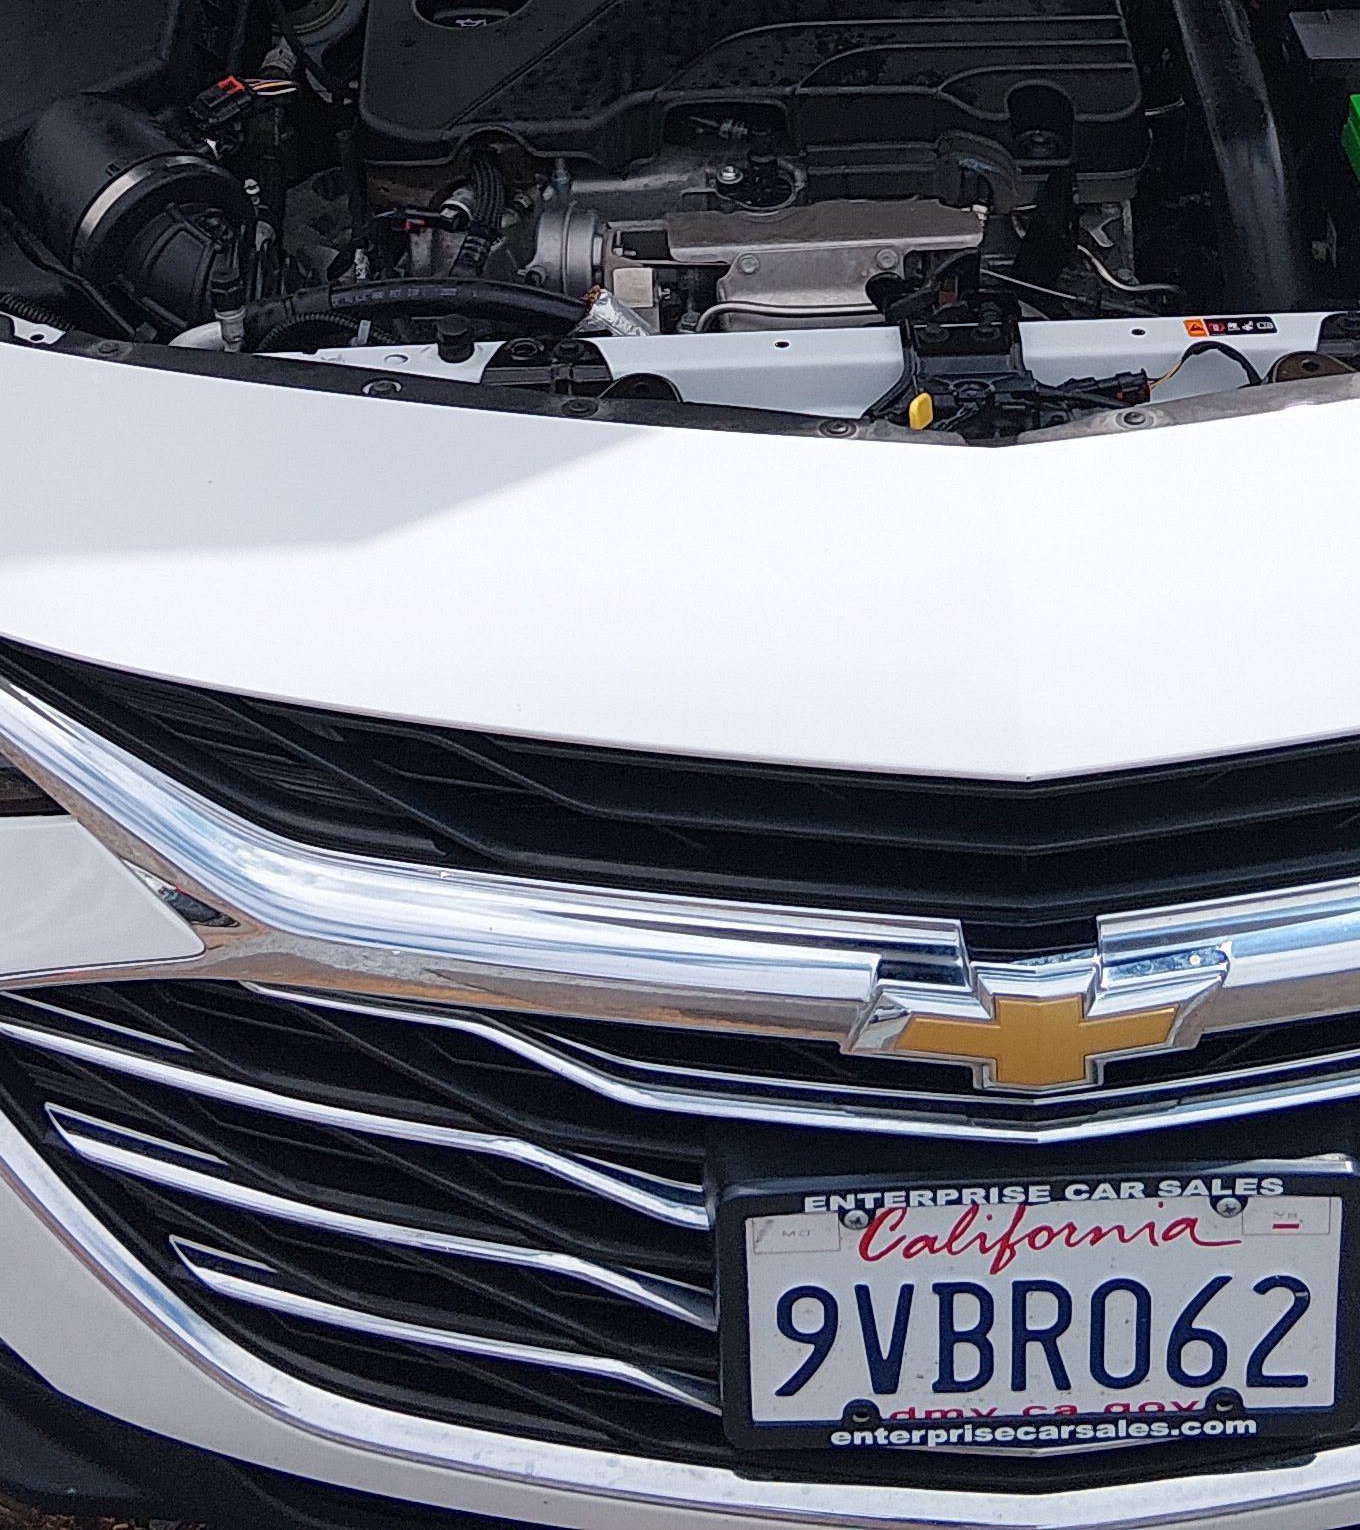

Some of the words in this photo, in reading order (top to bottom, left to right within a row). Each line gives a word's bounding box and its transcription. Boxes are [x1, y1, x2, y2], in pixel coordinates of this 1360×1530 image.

[804, 1185, 1051, 1212] ENTERPRISE
[1064, 1181, 1145, 1201] CAR
[1157, 1177, 1284, 1197] SALES
[858, 1201, 1242, 1275] California
[774, 1275, 1312, 1398] 9VBR062
[830, 1416, 1258, 1448] enterprisecarsales.com
